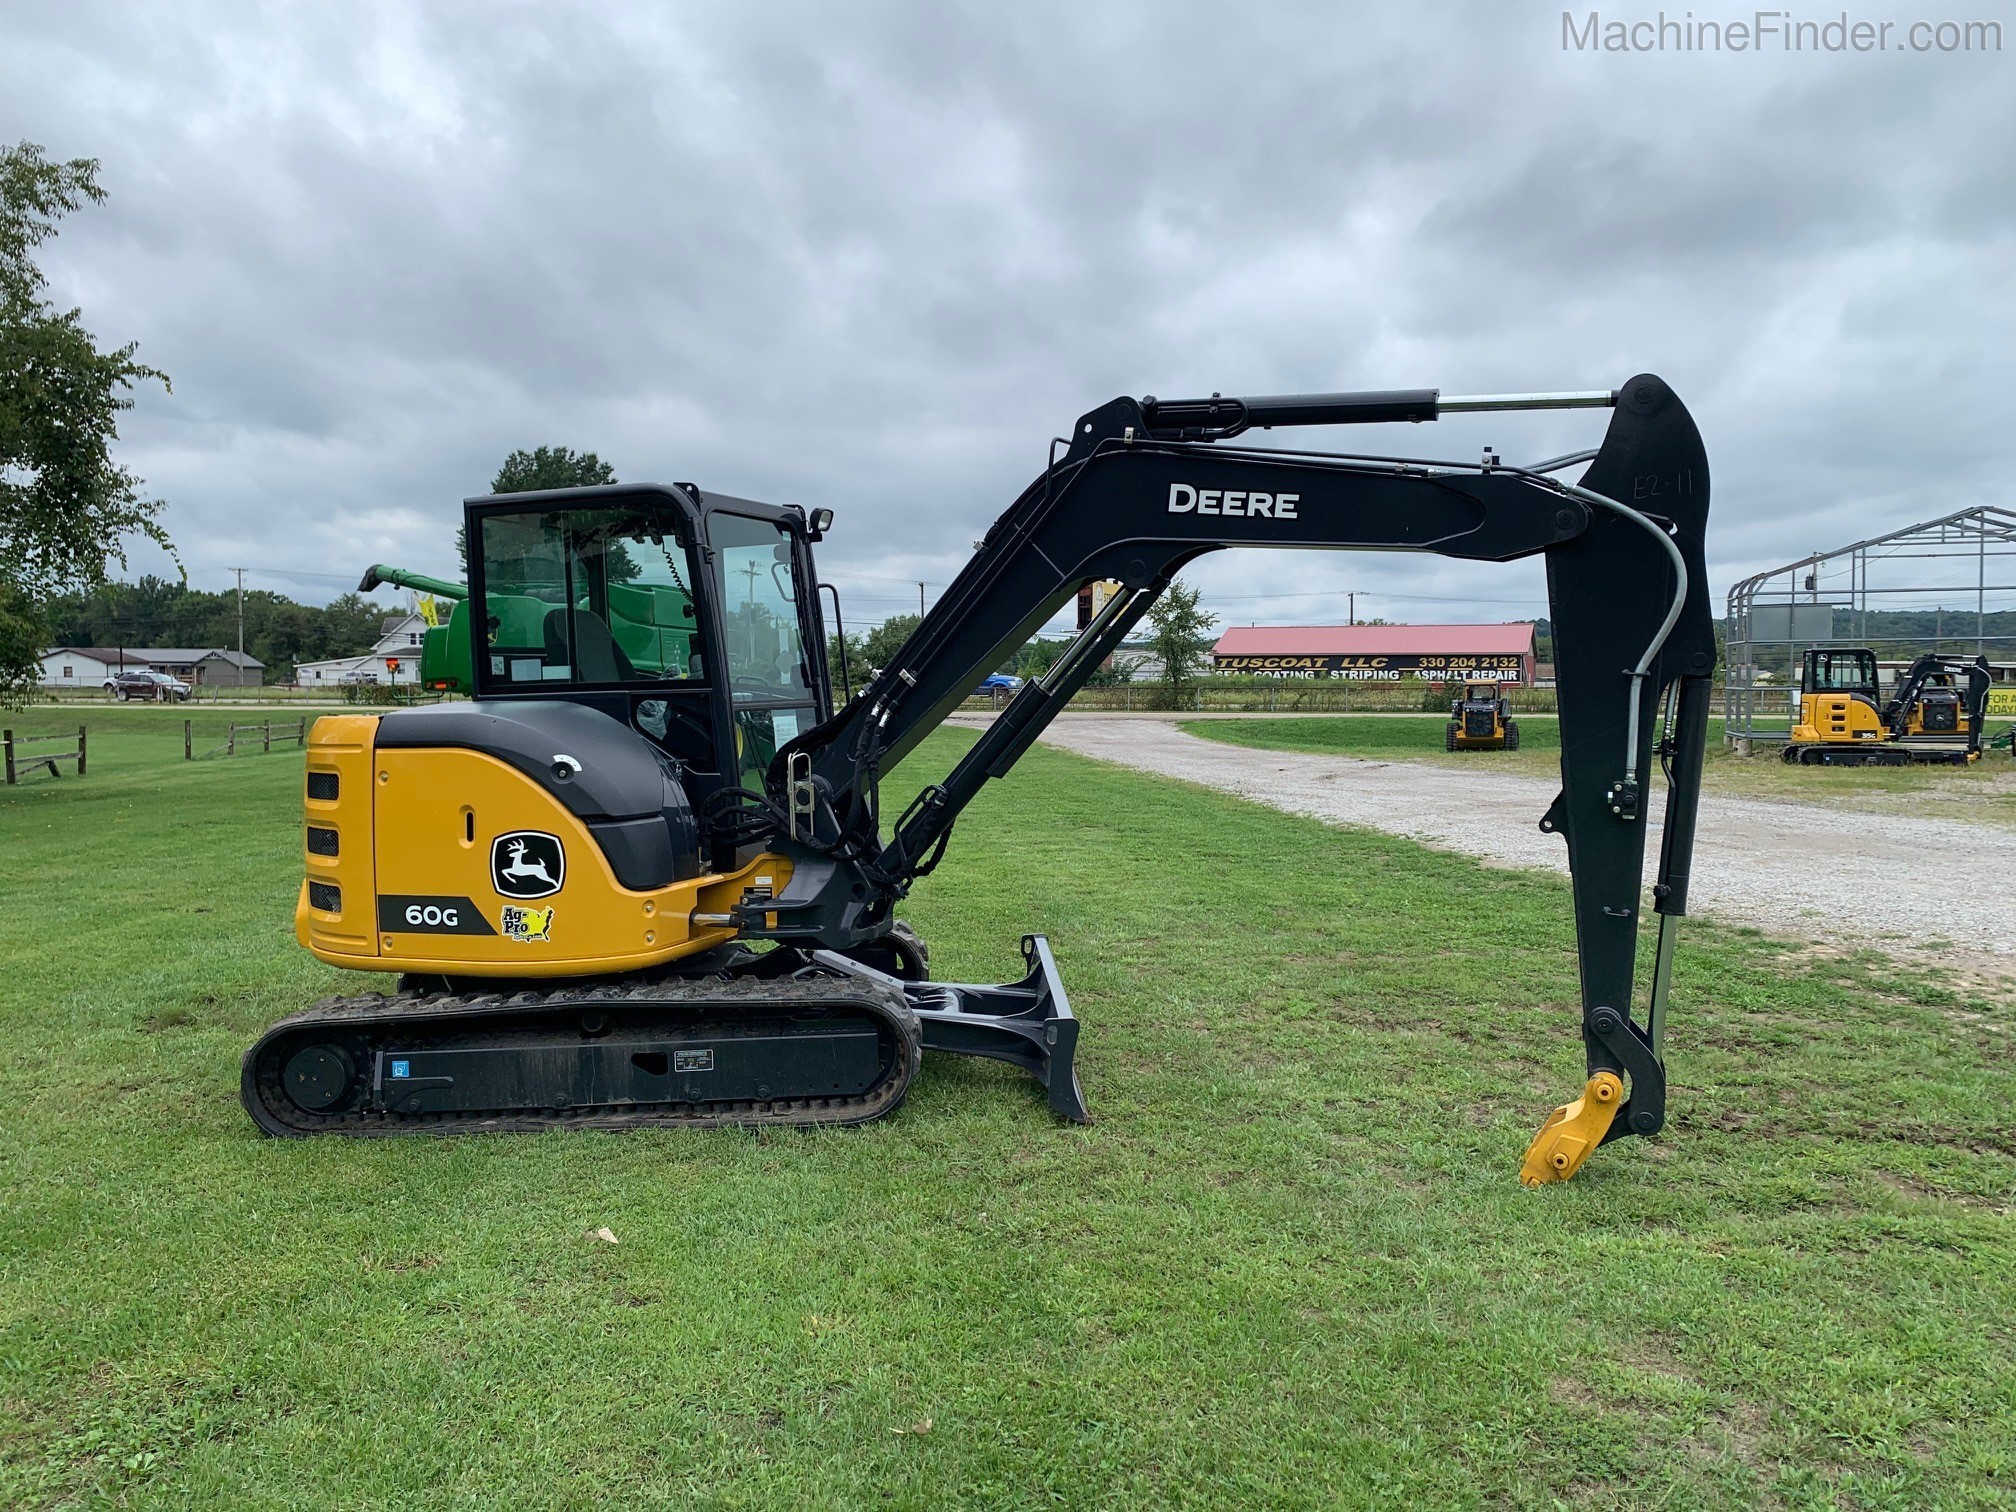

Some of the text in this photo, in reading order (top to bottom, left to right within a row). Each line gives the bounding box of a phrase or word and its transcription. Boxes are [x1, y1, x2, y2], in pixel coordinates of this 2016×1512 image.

[1168, 483, 1300, 519] DEERE
[1218, 657, 1519, 668] TUSCOAT LLC 330 204 2132
[1253, 670, 1315, 680] COATING
[1330, 670, 1400, 680] STRIPING
[1414, 670, 1470, 680] ASPHALT
[1472, 670, 1518, 680] REPAIR
[405, 904, 459, 926] 60G
[504, 920, 529, 933] Pro
